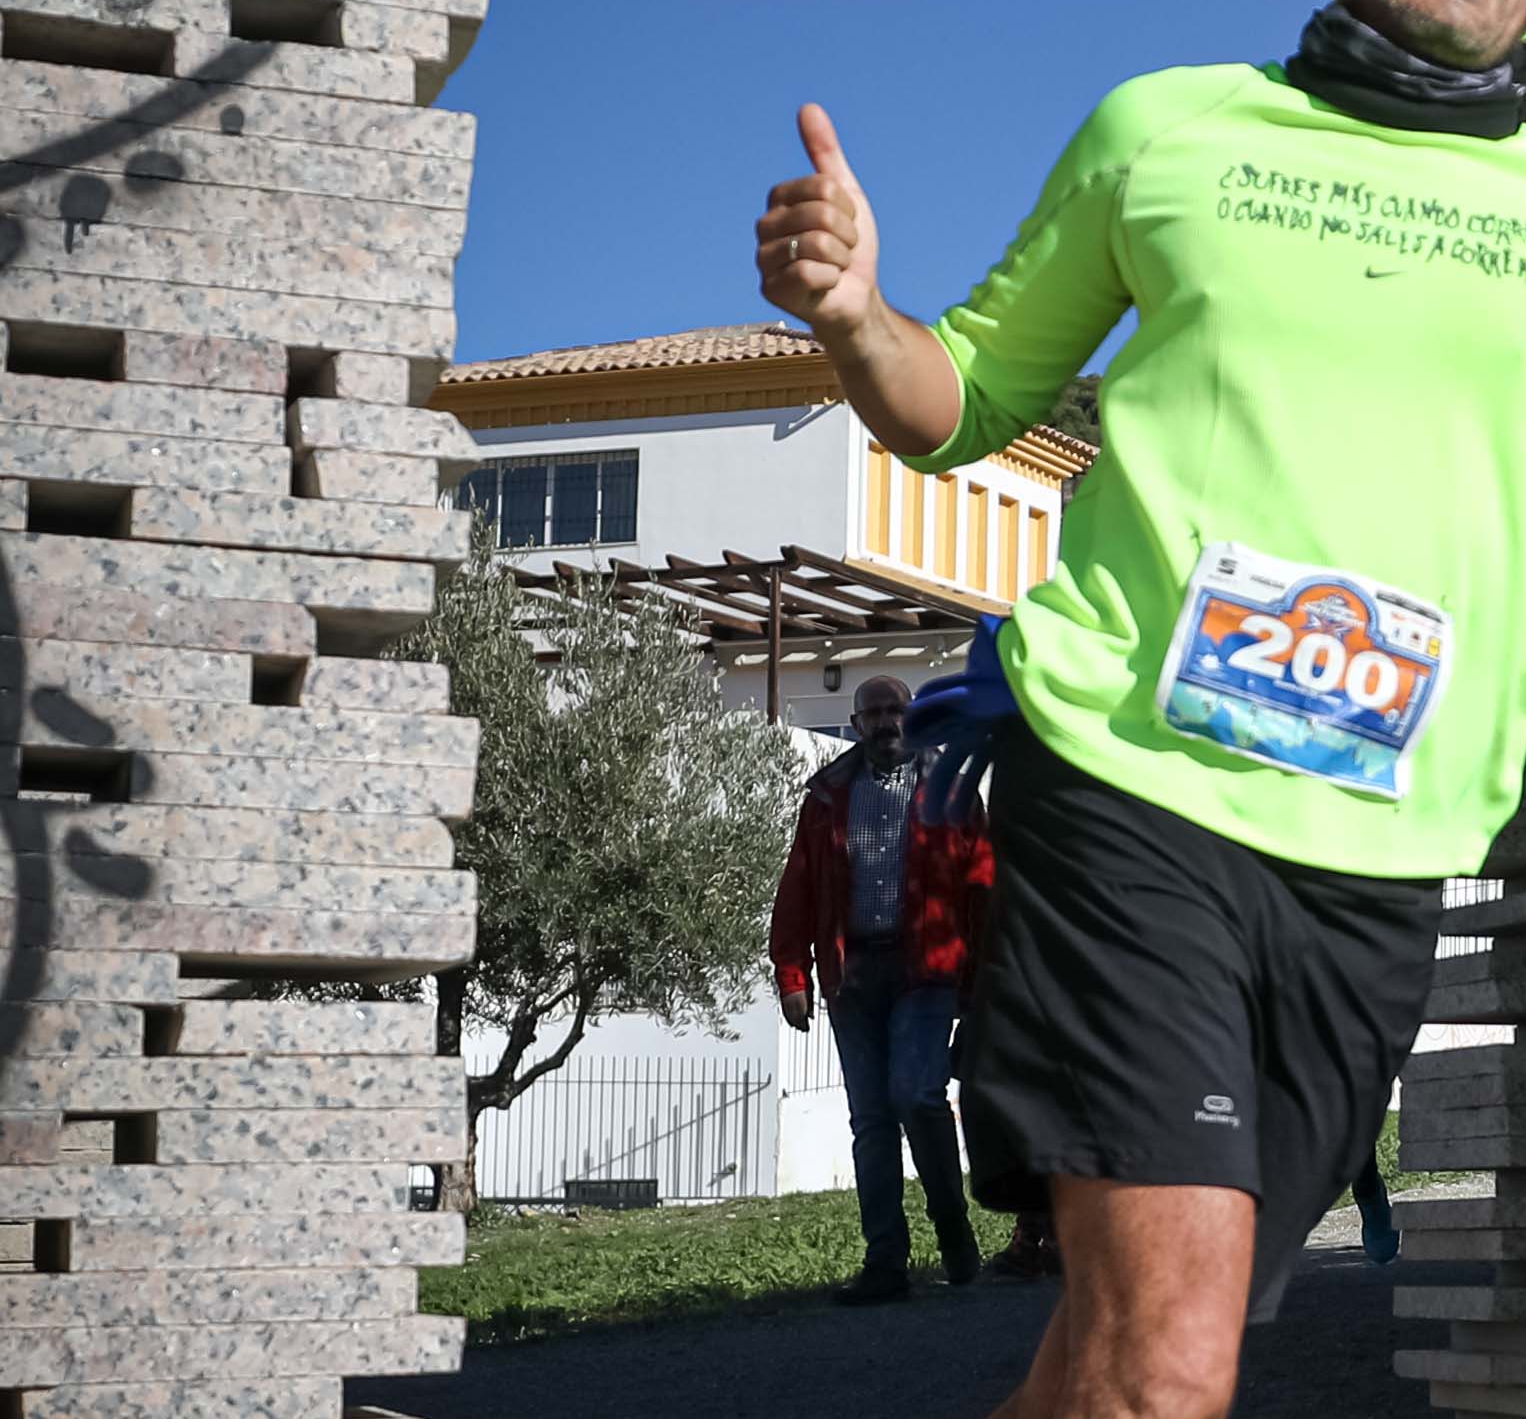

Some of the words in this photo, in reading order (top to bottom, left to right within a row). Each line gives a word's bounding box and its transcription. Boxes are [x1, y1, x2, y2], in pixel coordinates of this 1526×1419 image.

[1234, 197, 1313, 230] CUANDO
[1318, 214, 1352, 242] NO
[1426, 234, 1445, 263] A
[1227, 613, 1401, 711] 200
